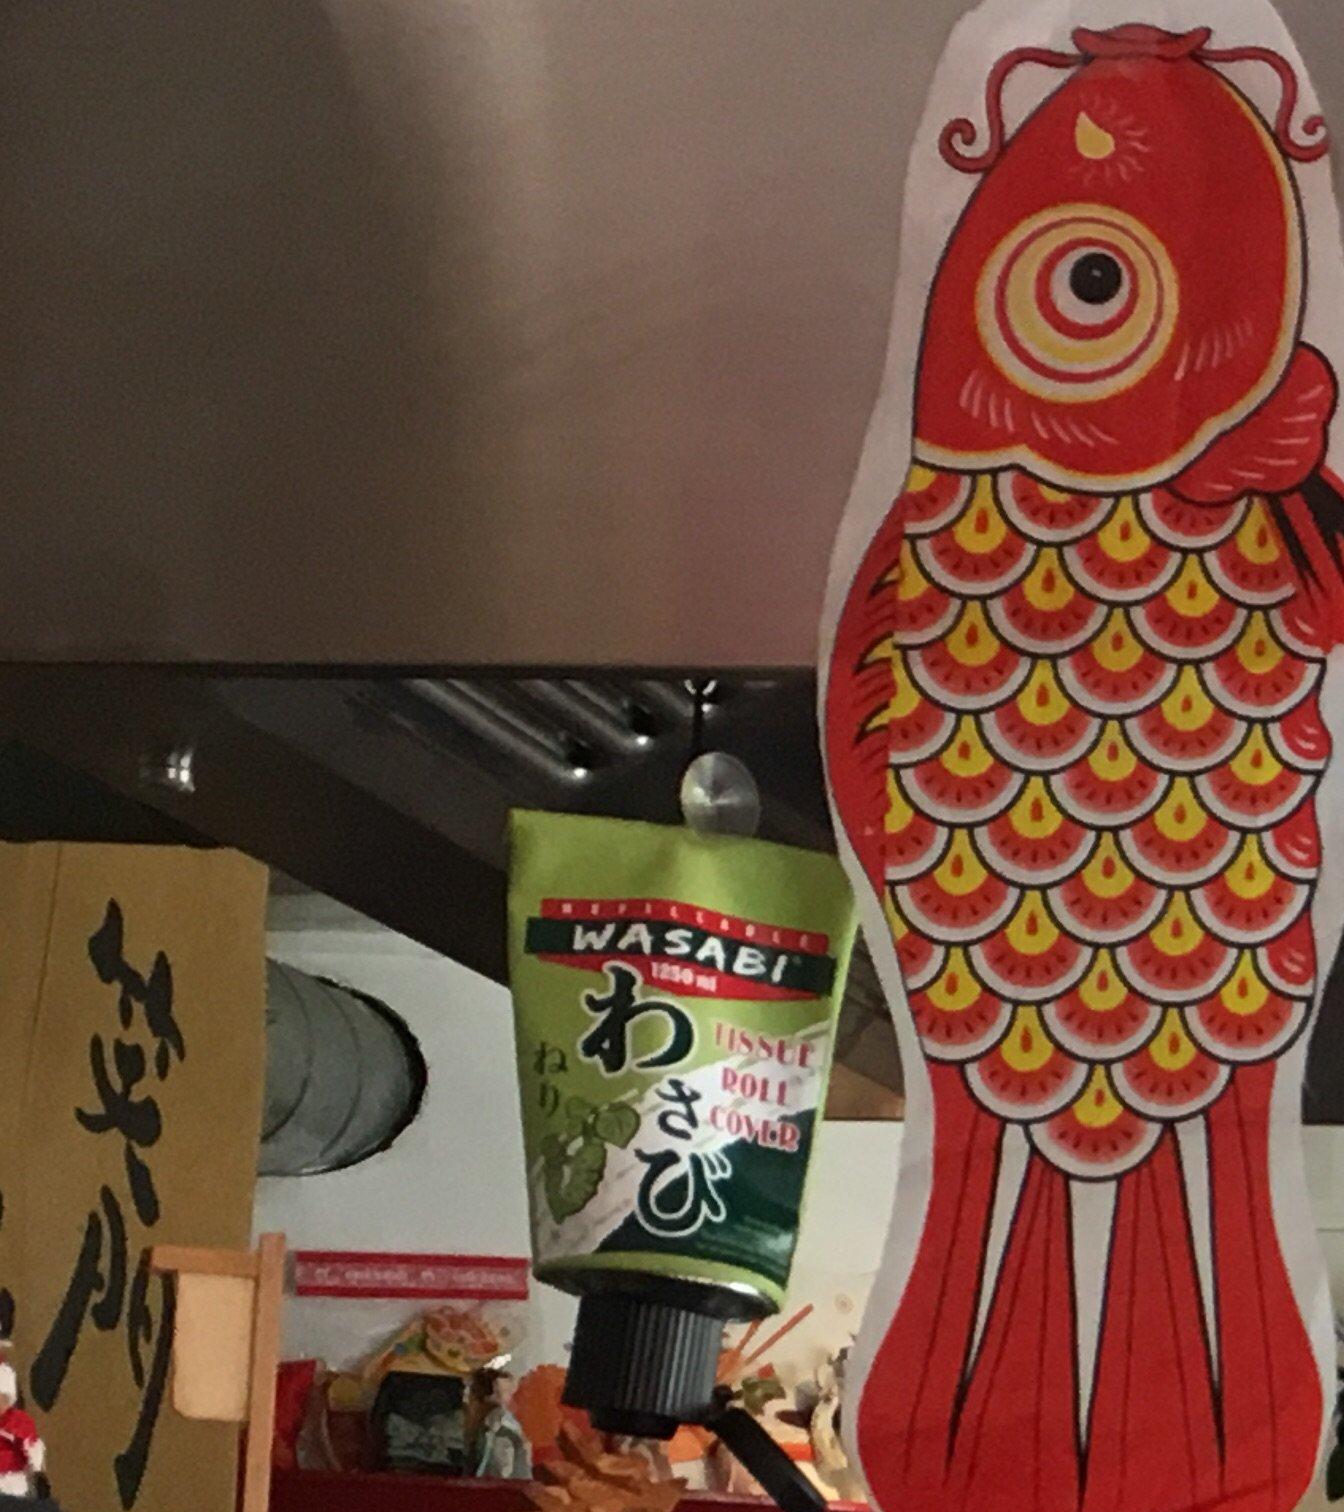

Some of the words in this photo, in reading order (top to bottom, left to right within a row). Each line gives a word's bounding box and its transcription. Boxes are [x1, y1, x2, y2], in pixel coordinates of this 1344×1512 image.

[572, 922, 789, 983] WASABI
[714, 1022, 816, 1068] TISSUE
[580, 961, 731, 1237] わさび
[720, 1066, 793, 1107] ROLL
[709, 1105, 801, 1152] COVER
